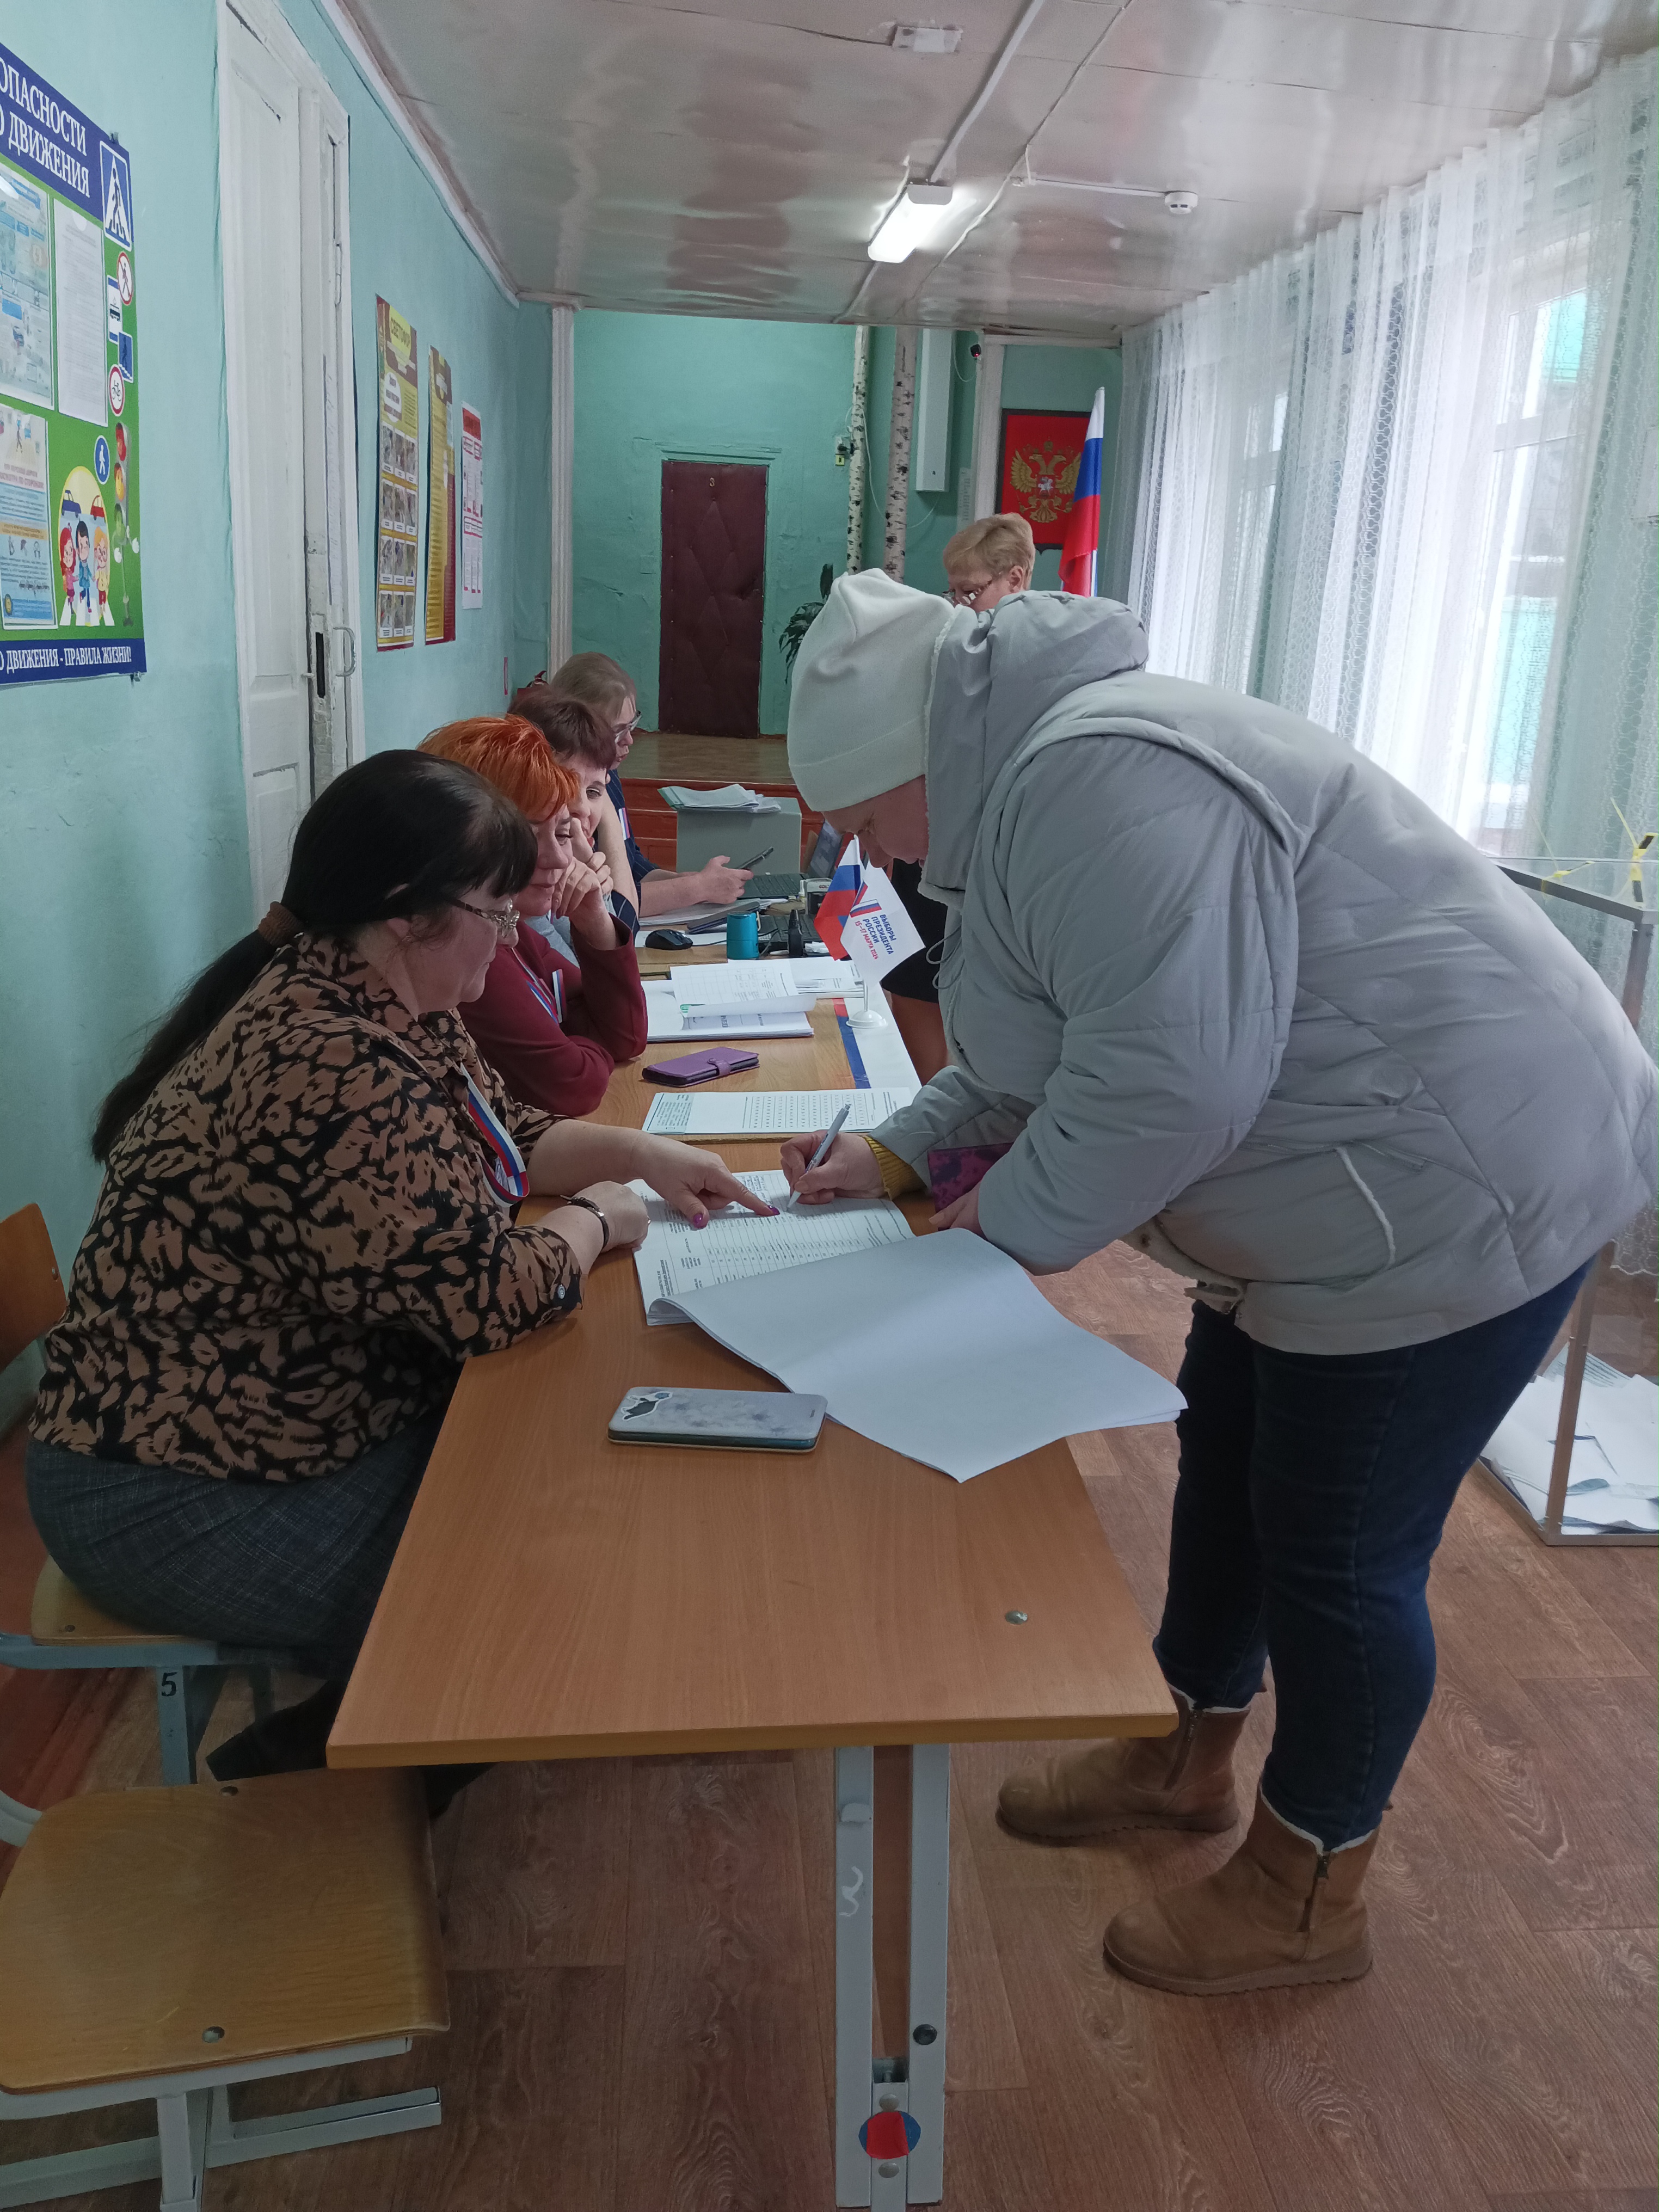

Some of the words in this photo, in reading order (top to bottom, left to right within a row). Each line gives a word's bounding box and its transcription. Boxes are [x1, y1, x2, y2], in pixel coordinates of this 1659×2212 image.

[8, 110, 90, 198] ДВИЖЕНИЯ
[6, 648, 59, 674] ДВИЖЕНИЯ
[64, 647, 102, 666] ПРАВИЛА
[102, 646, 132, 663] ЖИЗНИ!
[862, 918, 880, 943] РОССИИ
[863, 933, 874, 949] МАРТА
[871, 916, 894, 955] ПРЕЗИДЕНТА
[880, 914, 896, 941] ВЫБОРЫ
[162, 1672, 177, 1697] 5
